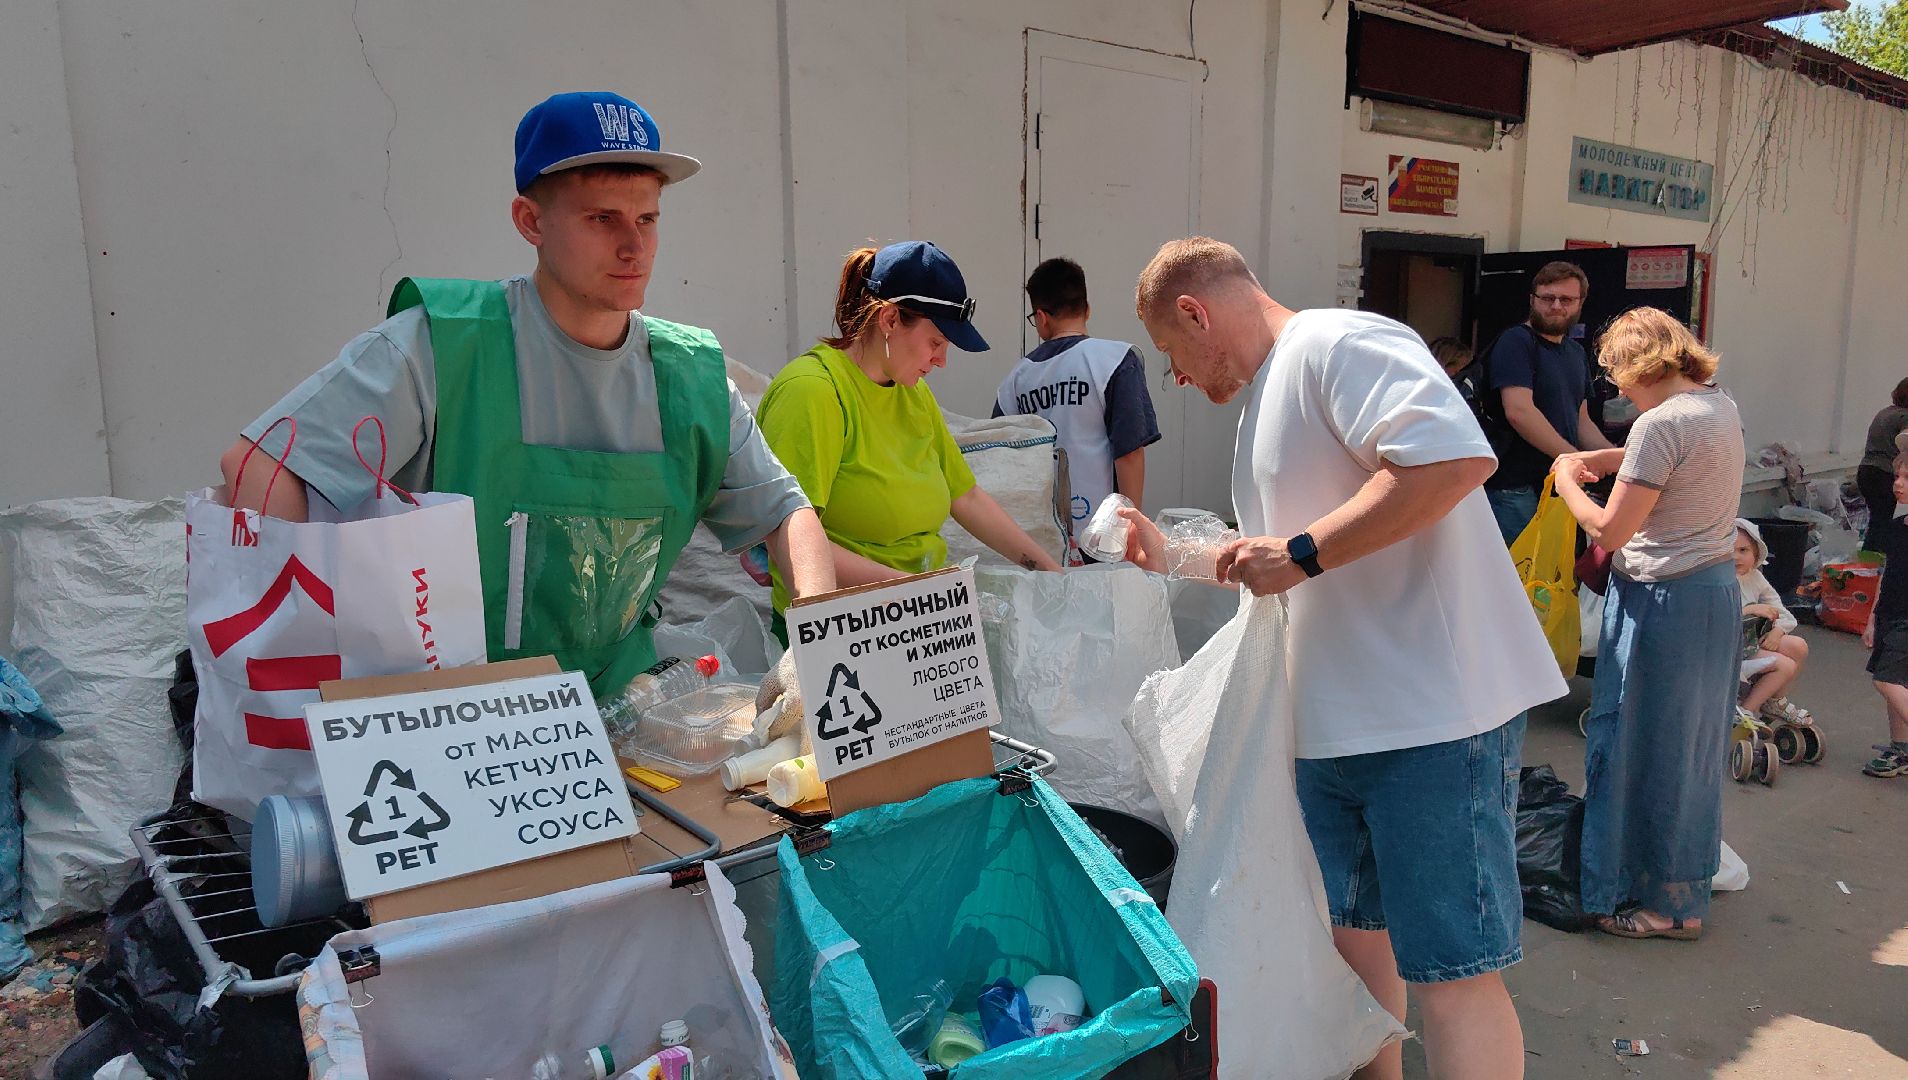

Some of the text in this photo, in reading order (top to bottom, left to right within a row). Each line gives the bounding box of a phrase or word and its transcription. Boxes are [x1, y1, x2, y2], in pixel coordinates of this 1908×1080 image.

[592, 102, 649, 146] WS
[601, 141, 627, 149] WAVE
[1578, 143, 1705, 180] МОЛОДЕЖНЫЙ ЦЕН
[798, 581, 969, 645] БУТЫЛОЧНЫЙ
[849, 613, 973, 658] ОТ КОСМЕТИКИ
[906, 631, 977, 663] И ХИМИИ
[912, 655, 979, 687] ЛЮБОГО
[933, 675, 984, 702] ЦВЕТА
[322, 682, 583, 742] БУТЫЛОЧНЫЙ
[839, 696, 855, 718] 1
[884, 700, 986, 739] НЕСТАНДАРТНЫЕ ЦВЕТА
[485, 719, 594, 754] МАСЛА
[888, 710, 988, 749] БУТЫЛОК ОТ НАПИТКОВ
[463, 748, 604, 790] КЕТЧУПА
[384, 796, 407, 820] 1
[488, 777, 614, 818] УКСУСА
[517, 806, 624, 845] СОУСА
